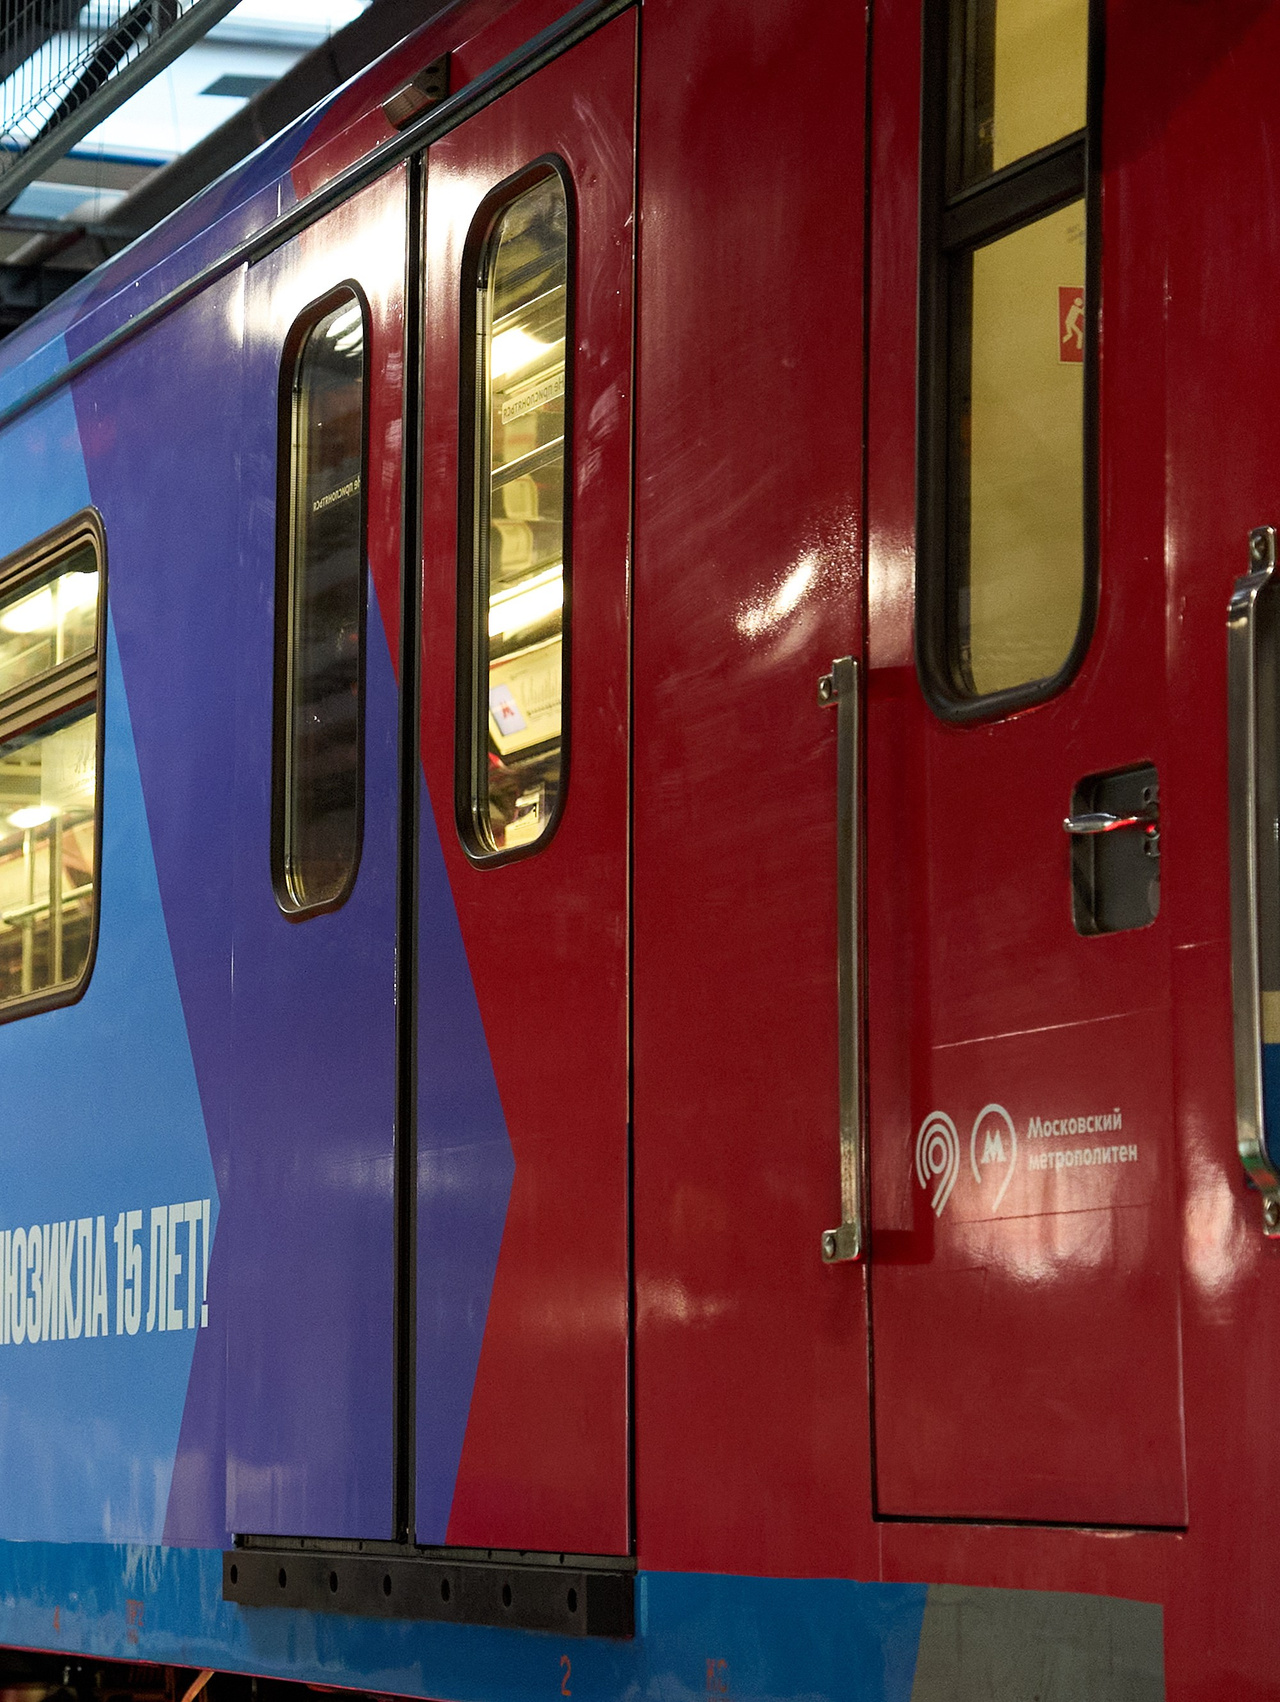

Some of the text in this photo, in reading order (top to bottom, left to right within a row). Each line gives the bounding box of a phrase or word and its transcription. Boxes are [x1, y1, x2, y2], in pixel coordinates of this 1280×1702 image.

[1027, 1108, 1122, 1139] Московский
[1028, 1144, 1138, 1172] метрополитен
[114, 1209, 142, 1335] 15
[147, 1199, 211, 1333] ЛЕТ!
[560, 1655, 571, 1696] 2
